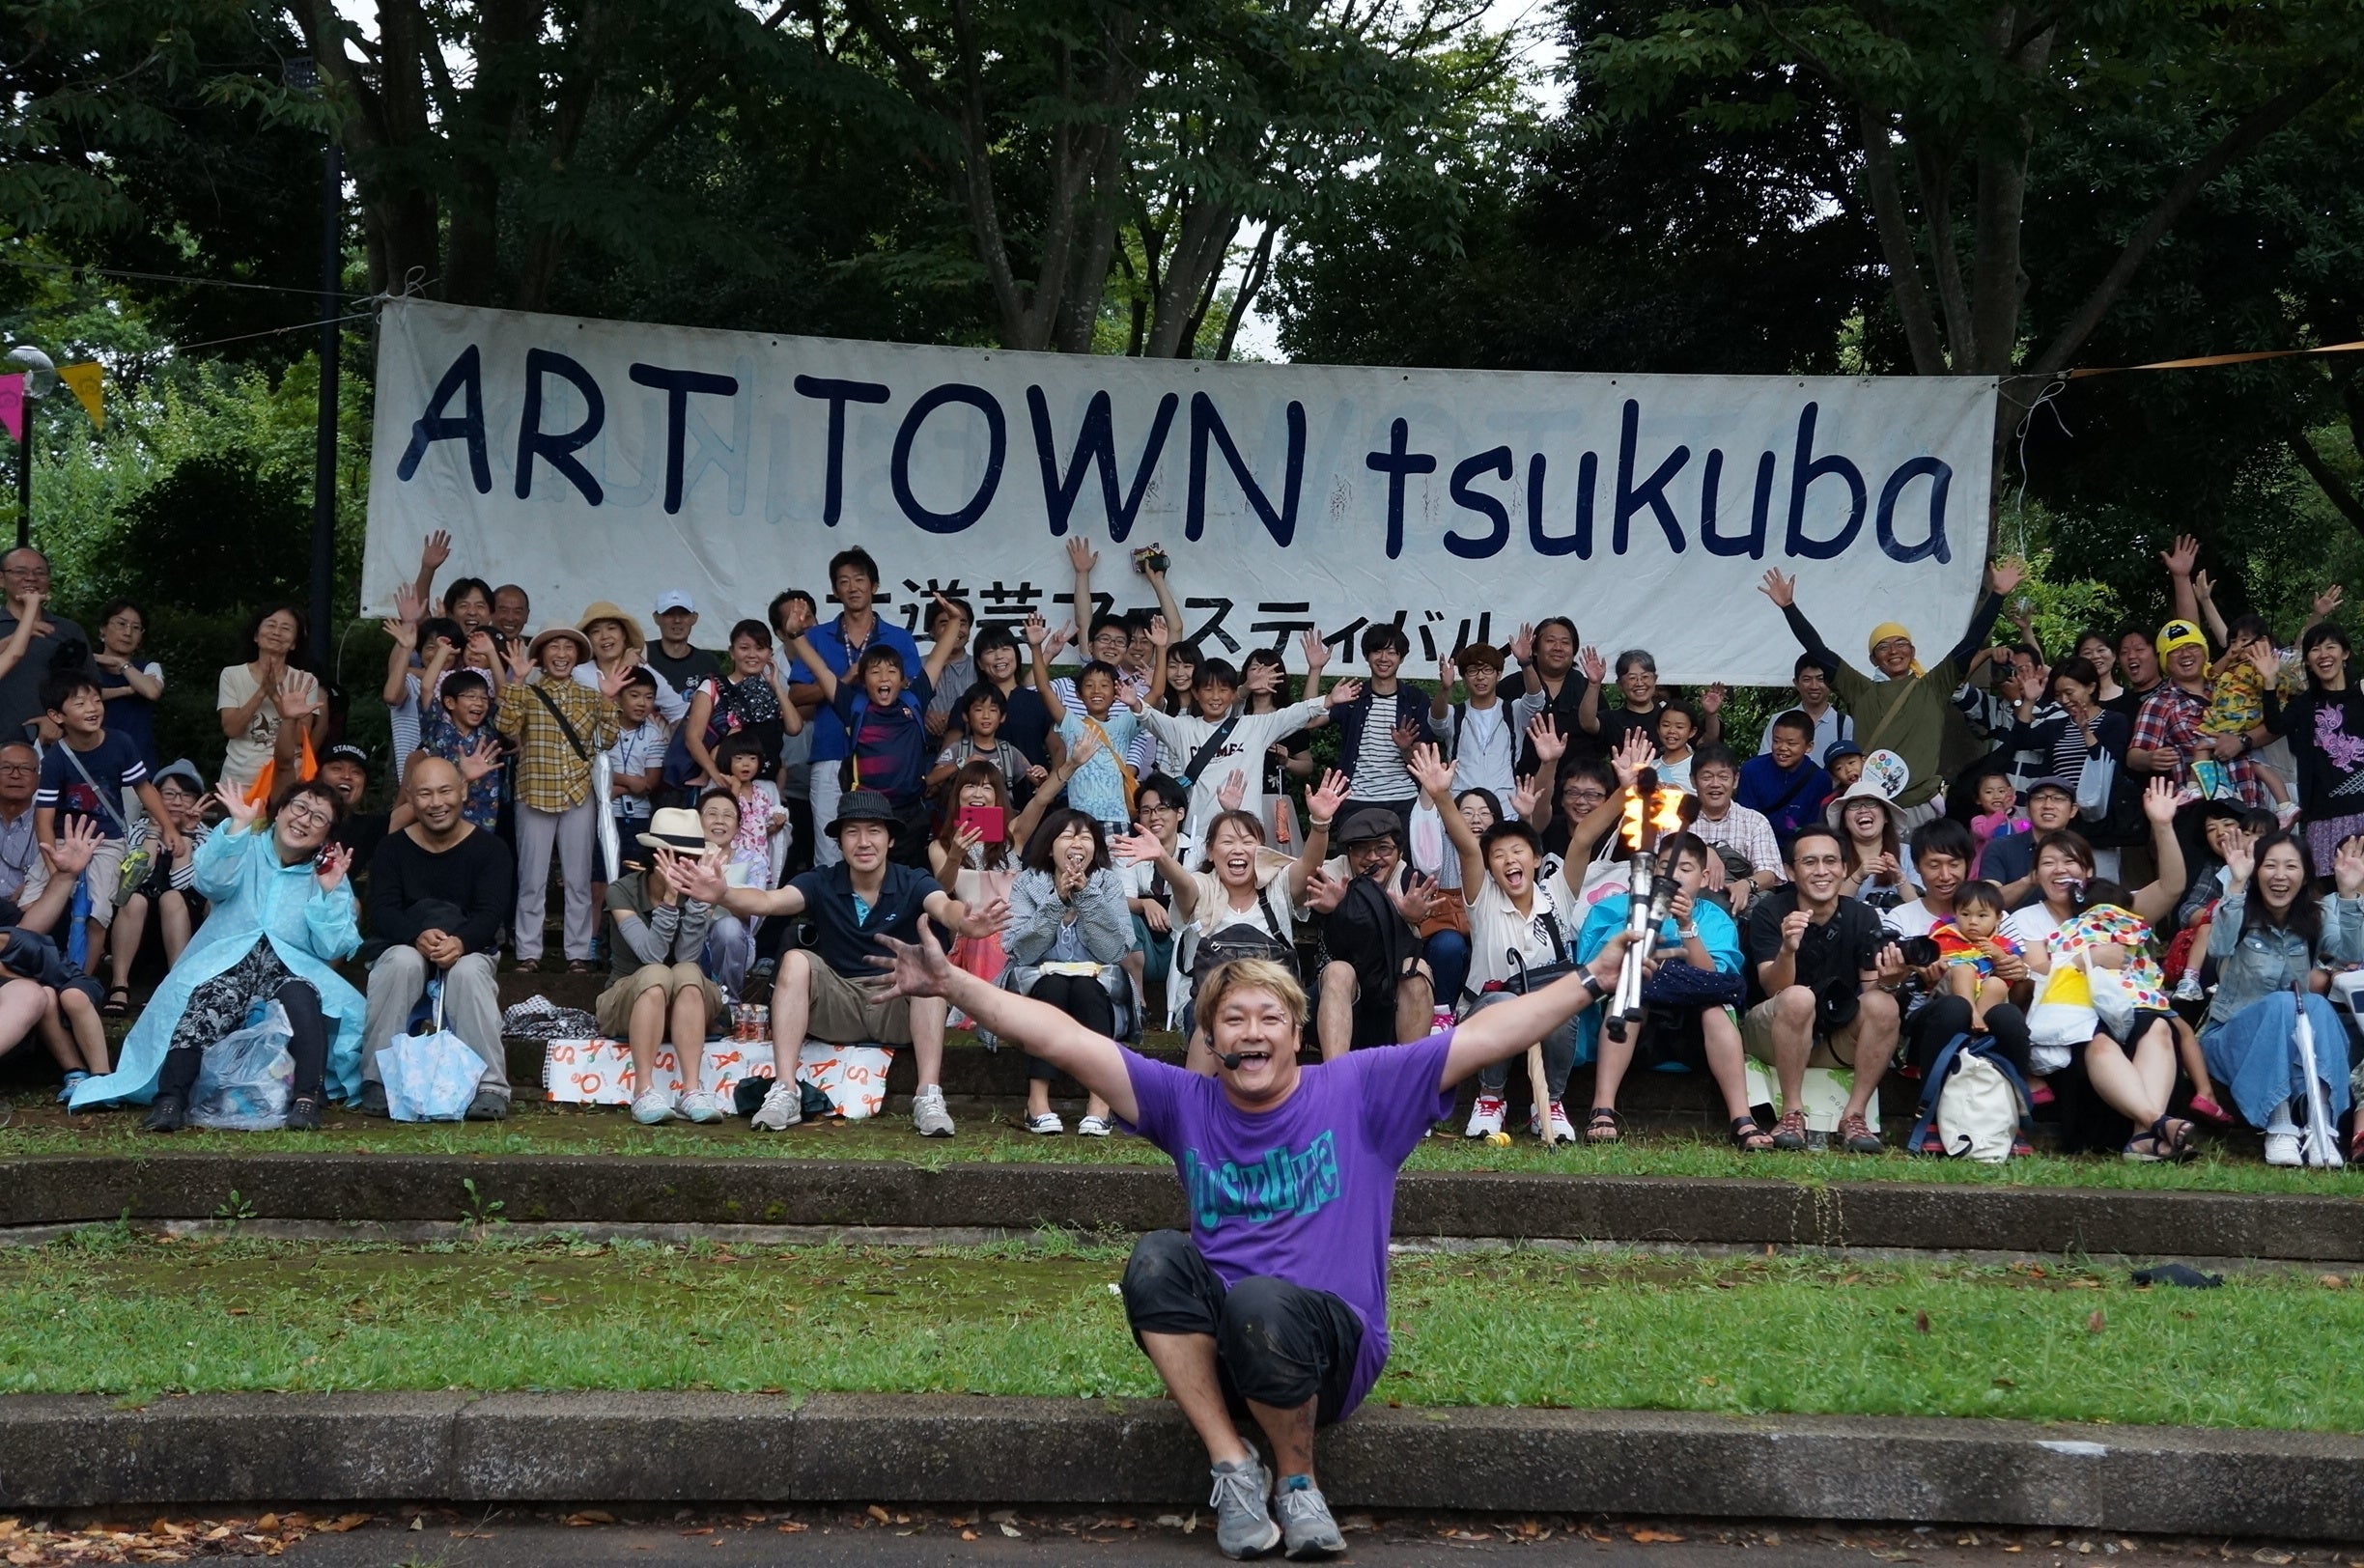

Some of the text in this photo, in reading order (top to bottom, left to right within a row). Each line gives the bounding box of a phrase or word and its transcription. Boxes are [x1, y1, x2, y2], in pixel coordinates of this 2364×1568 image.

[396, 344, 1953, 565] ART TOWN tsukuba
